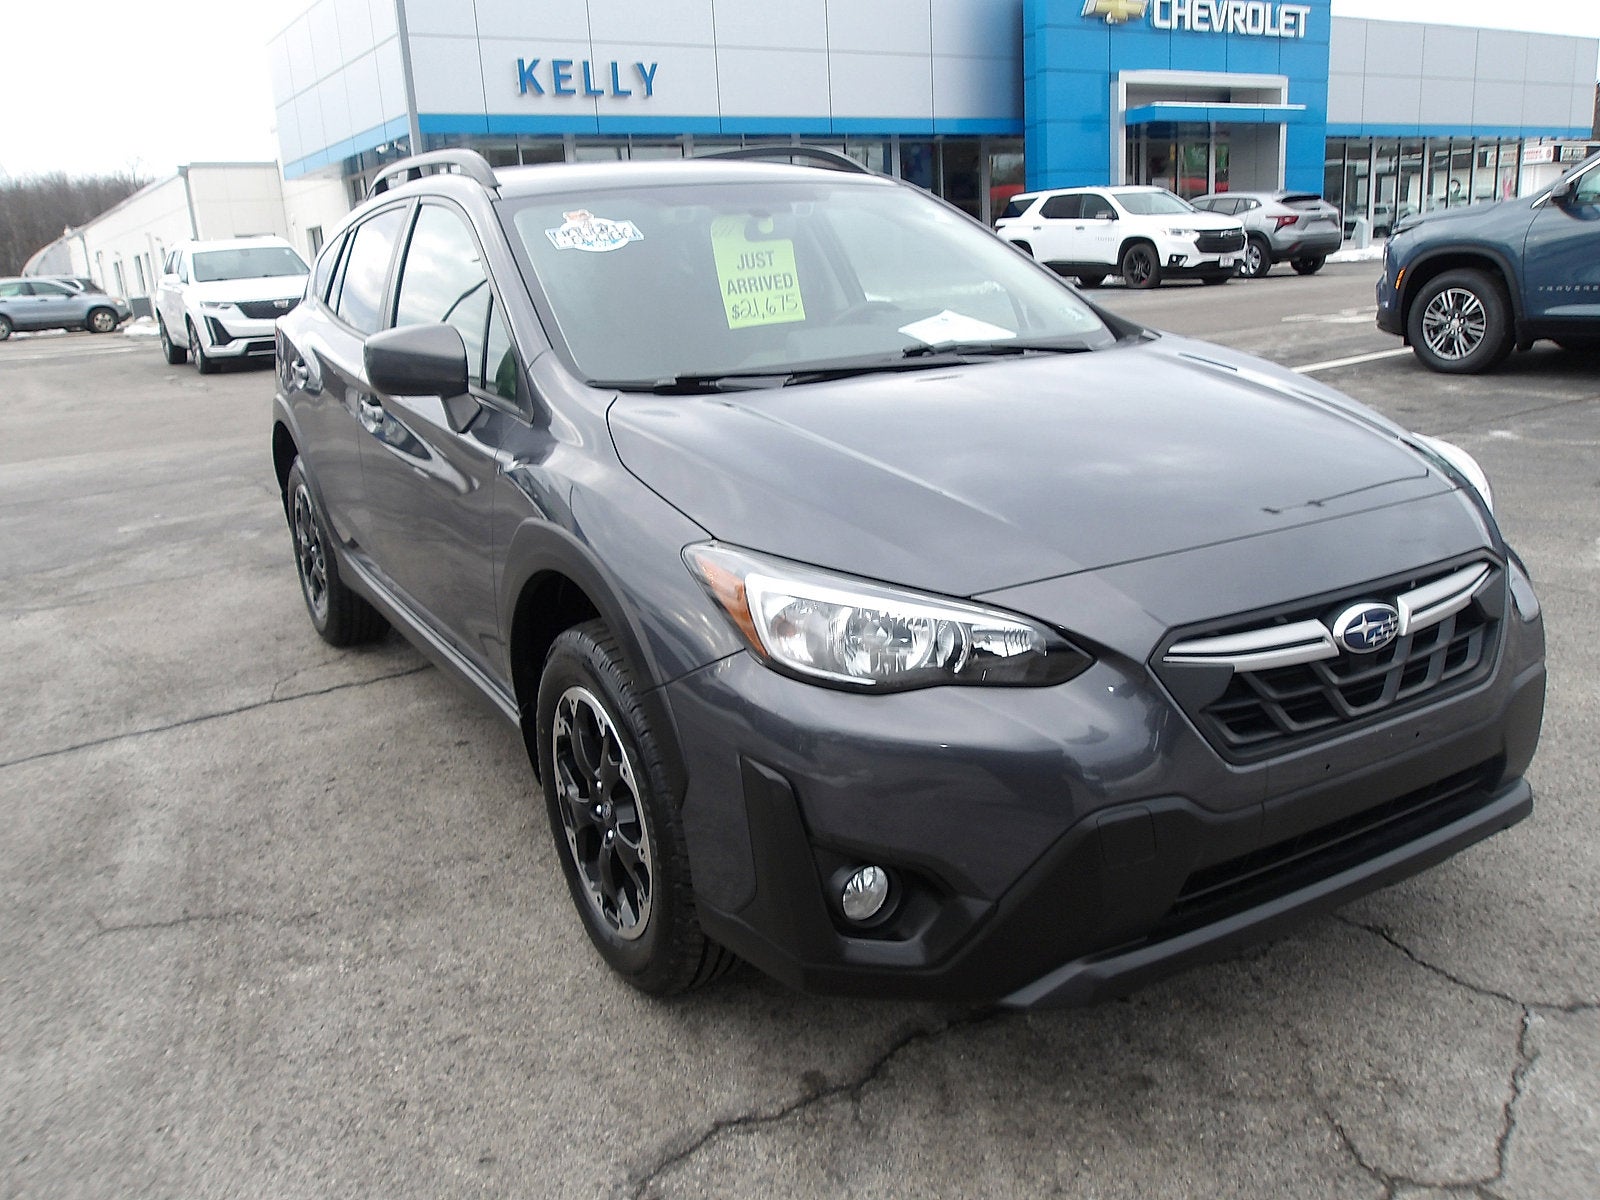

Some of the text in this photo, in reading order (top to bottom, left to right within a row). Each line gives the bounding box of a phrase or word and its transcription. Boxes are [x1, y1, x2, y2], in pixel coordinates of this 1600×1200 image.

[1152, 0, 1311, 38] CHEVROLET
[517, 58, 658, 96] KELLY
[737, 250, 774, 270] JUST
[727, 272, 794, 295] ARRIVED
